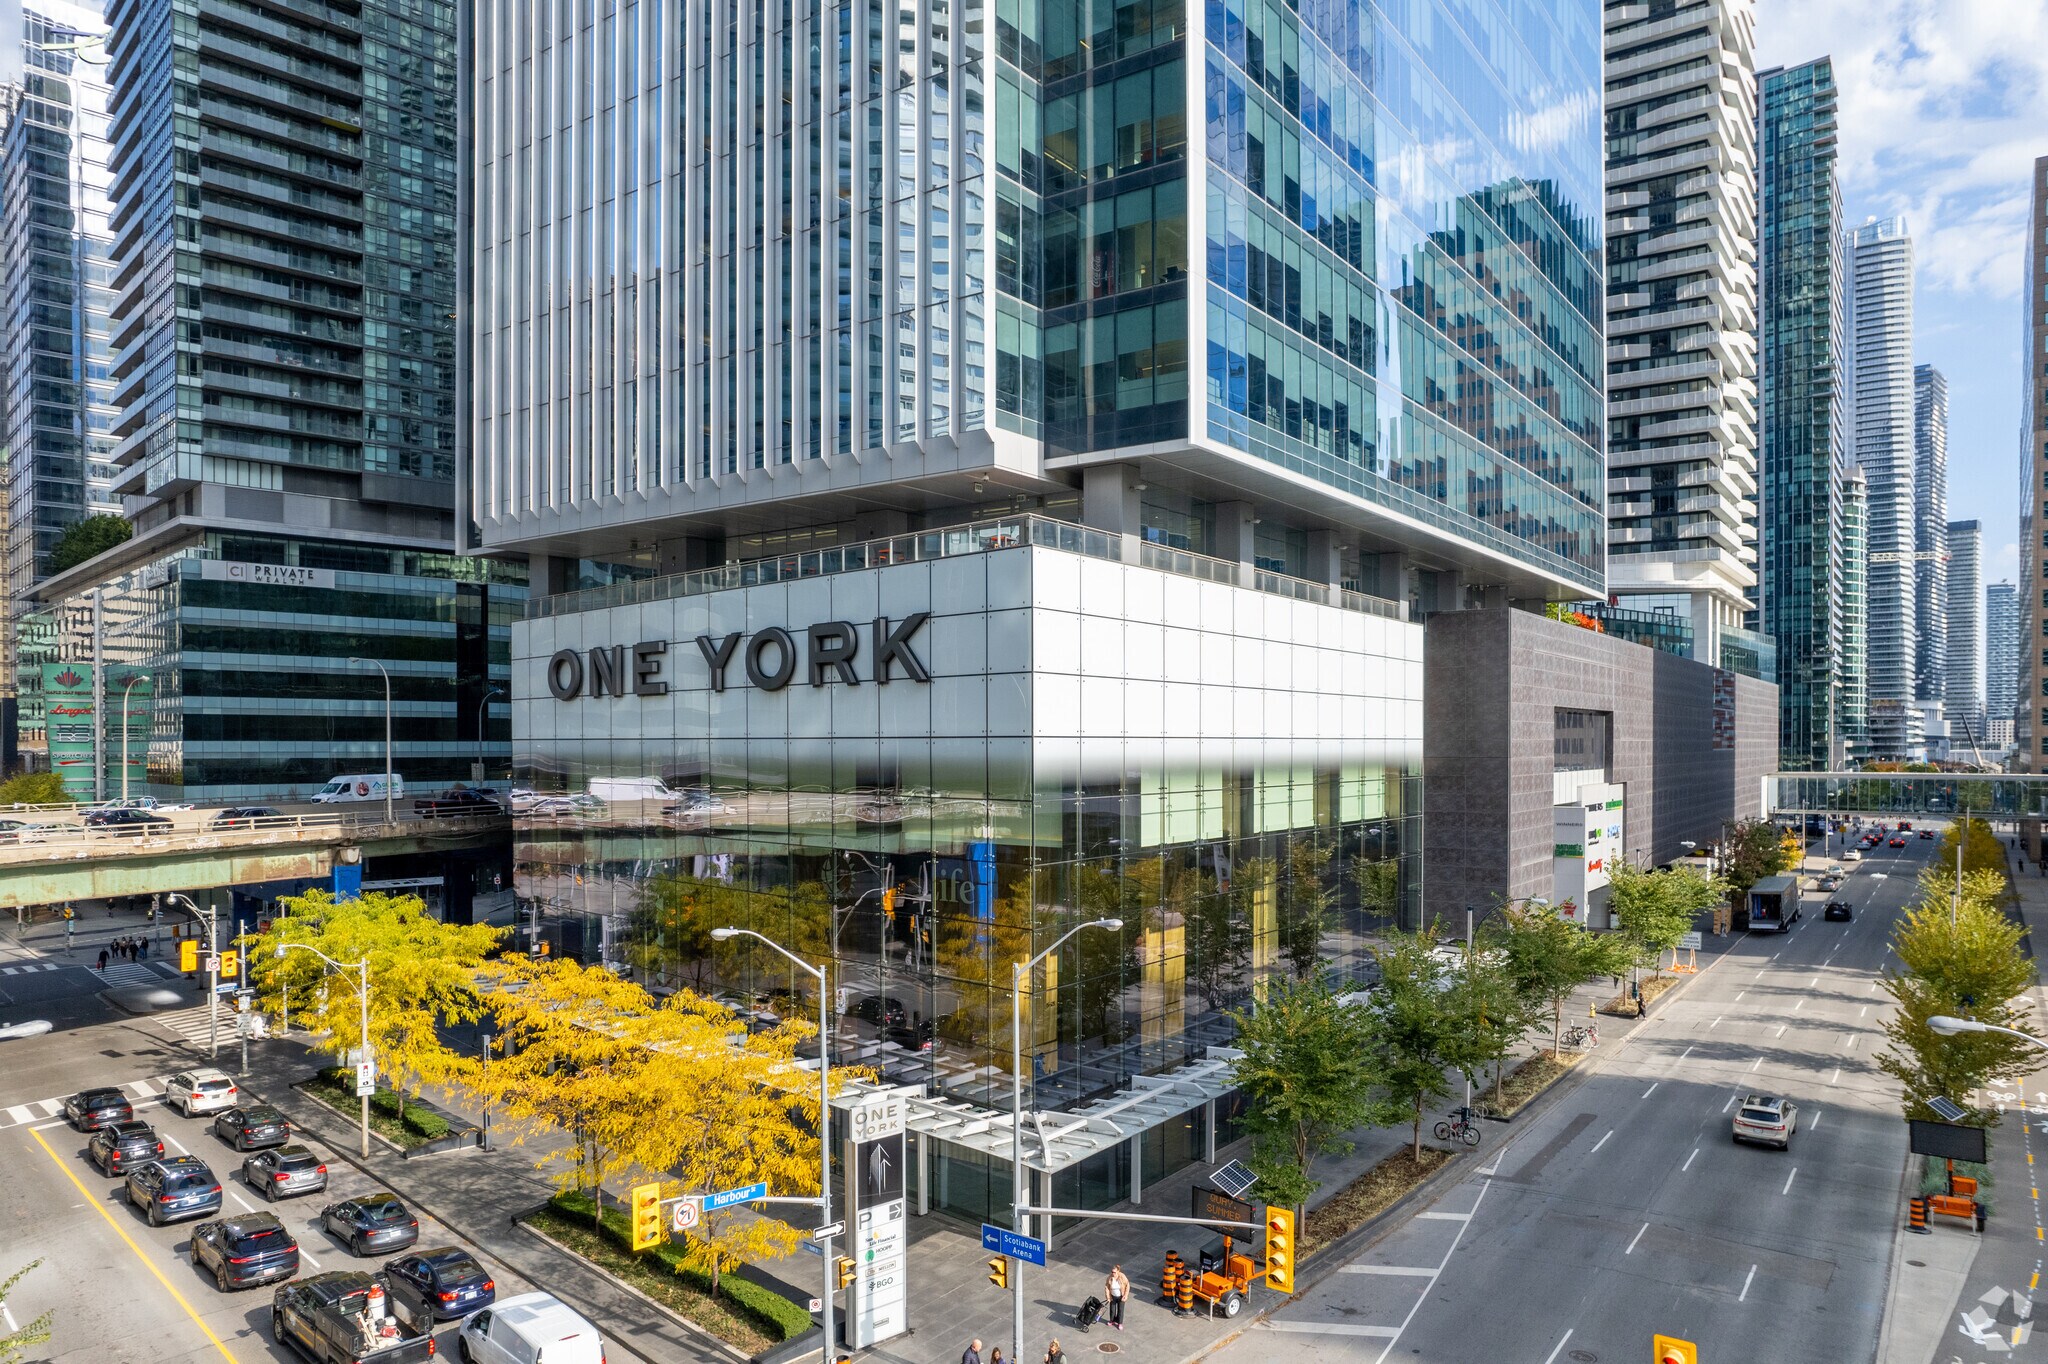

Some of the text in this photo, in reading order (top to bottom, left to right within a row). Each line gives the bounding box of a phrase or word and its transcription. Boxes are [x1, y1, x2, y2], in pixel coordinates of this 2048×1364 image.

[230, 565, 314, 580] CI PRIVATE
[255, 575, 304, 585] WEALTH
[548, 612, 932, 701] ONE YORK
[855, 1104, 898, 1125] ONE
[856, 1120, 898, 1137] YORK
[714, 1188, 751, 1206] Harbour
[859, 1211, 872, 1230] P
[1206, 1203, 1241, 1222] SUMMER
[877, 1233, 897, 1244] Financial
[1004, 1234, 1041, 1252] Scotiabank
[1012, 1246, 1033, 1259] Arena
[878, 1263, 895, 1271] MELLON
[876, 1277, 894, 1289] BGO
